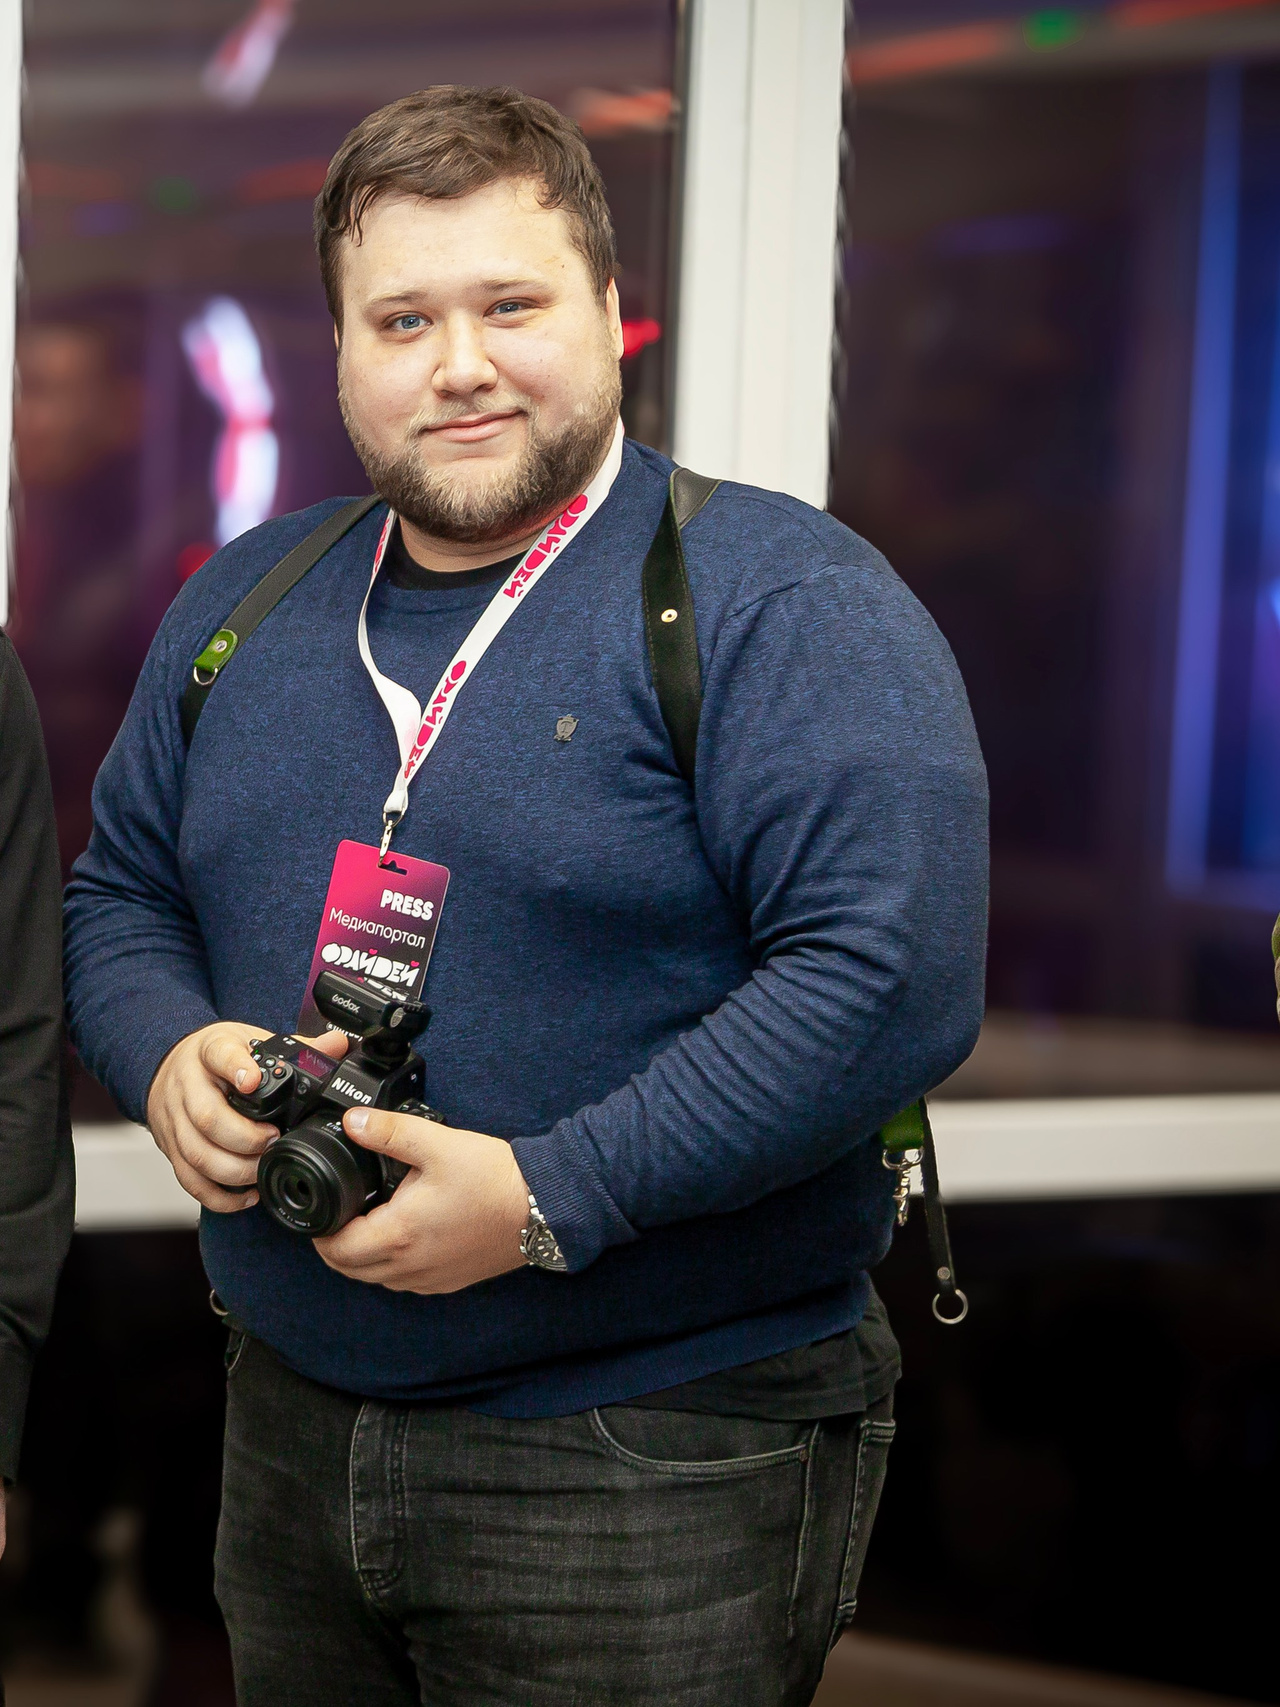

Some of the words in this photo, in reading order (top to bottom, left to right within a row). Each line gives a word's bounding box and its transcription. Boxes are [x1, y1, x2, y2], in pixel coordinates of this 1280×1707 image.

[380, 889, 434, 921] PRESS
[329, 907, 426, 949] Медиапортал
[331, 1077, 372, 1105] Nikon
